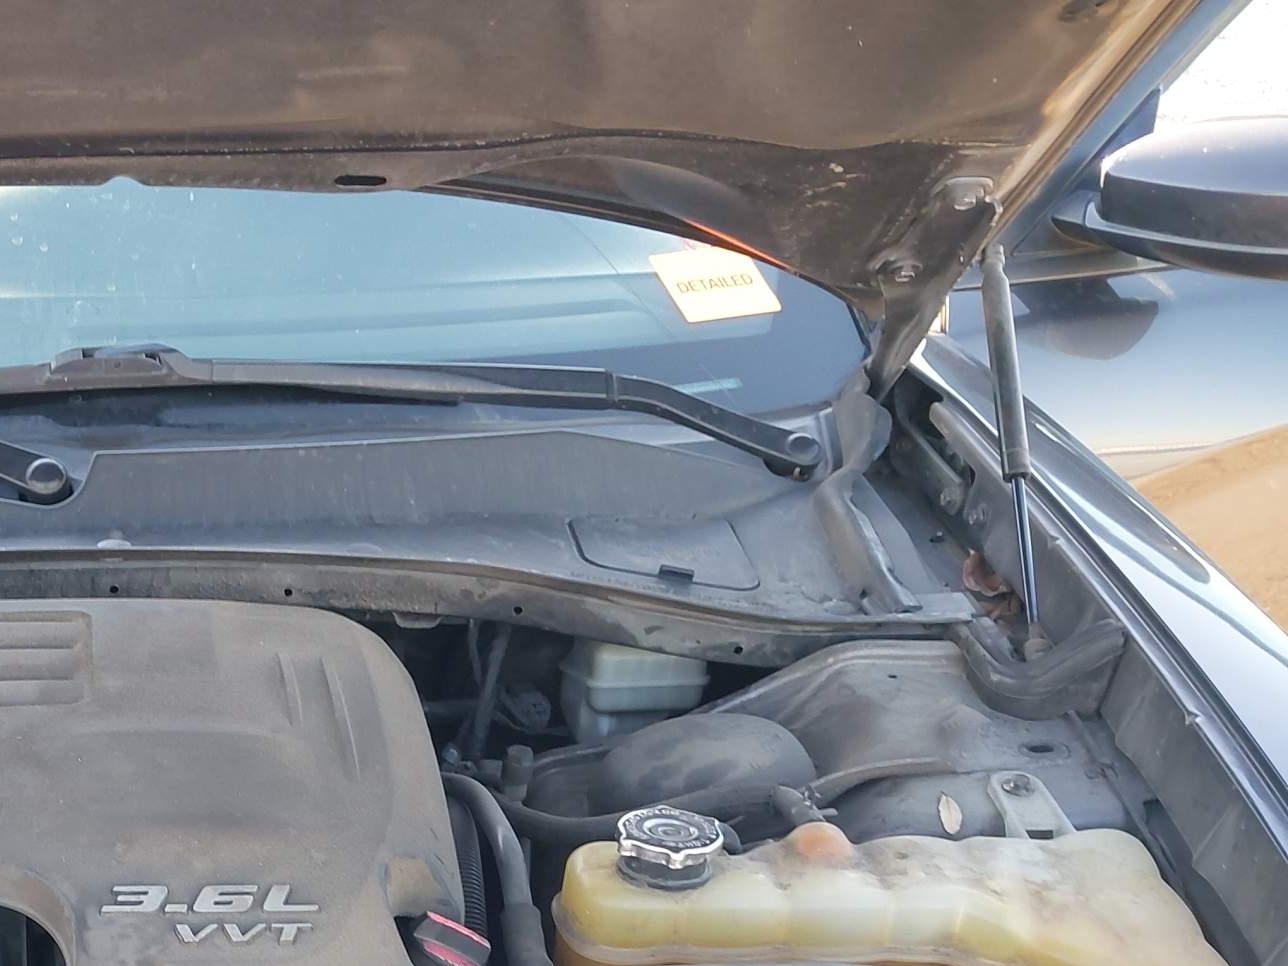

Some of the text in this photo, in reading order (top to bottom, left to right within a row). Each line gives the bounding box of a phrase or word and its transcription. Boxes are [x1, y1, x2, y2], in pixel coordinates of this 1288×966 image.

[676, 274, 753, 293] DETAILED
[100, 884, 320, 914] 3.6L
[174, 922, 313, 945] VVT
